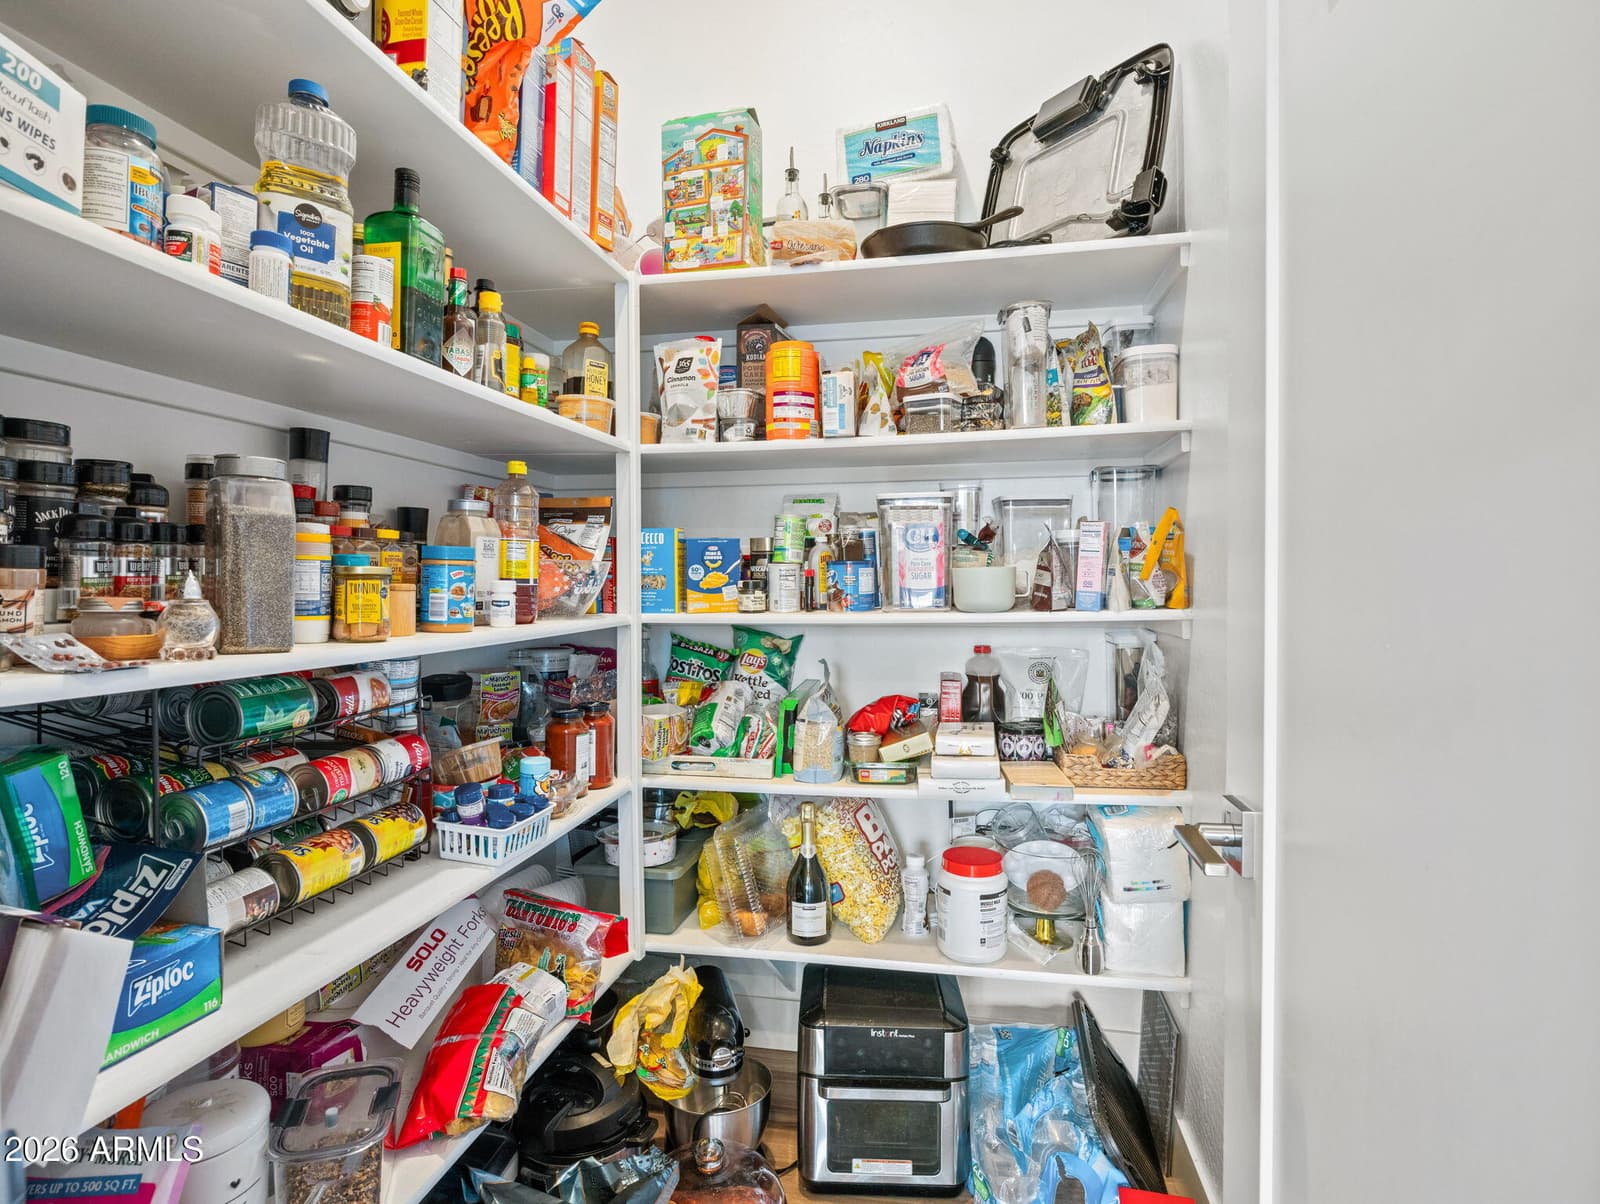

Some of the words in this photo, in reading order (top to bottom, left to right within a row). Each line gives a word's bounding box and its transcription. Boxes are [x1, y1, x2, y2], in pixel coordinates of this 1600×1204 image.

[2, 52, 42, 91] 200
[17, 117, 56, 150] WIPES
[858, 130, 925, 157] Napkins
[853, 175, 870, 184] 280
[283, 231, 331, 250] Vegetable
[299, 245, 314, 254] Oil
[586, 374, 607, 386] HONEY
[667, 375, 696, 383] Cinnamon
[34, 508, 59, 523] JACK
[670, 656, 721, 682] OSTITOS
[742, 653, 767, 669] Lay's
[488, 673, 518, 682] Maruchan
[58, 761, 70, 780] 120
[73, 820, 94, 874] SANDWICH
[406, 927, 447, 973] SOLO
[499, 938, 516, 950] Bag
[385, 938, 465, 1029] Heavyweight
[457, 907, 488, 939] Forks
[133, 960, 195, 1005] Ziploc
[203, 997, 218, 1012] 116
[103, 1028, 160, 1062] ANDWICH
[49, 1181, 62, 1194] UP
[64, 1180, 77, 1193] TO
[81, 1180, 102, 1192] 500
[104, 1179, 119, 1192] SQ
[121, 1177, 137, 1191] FT.
